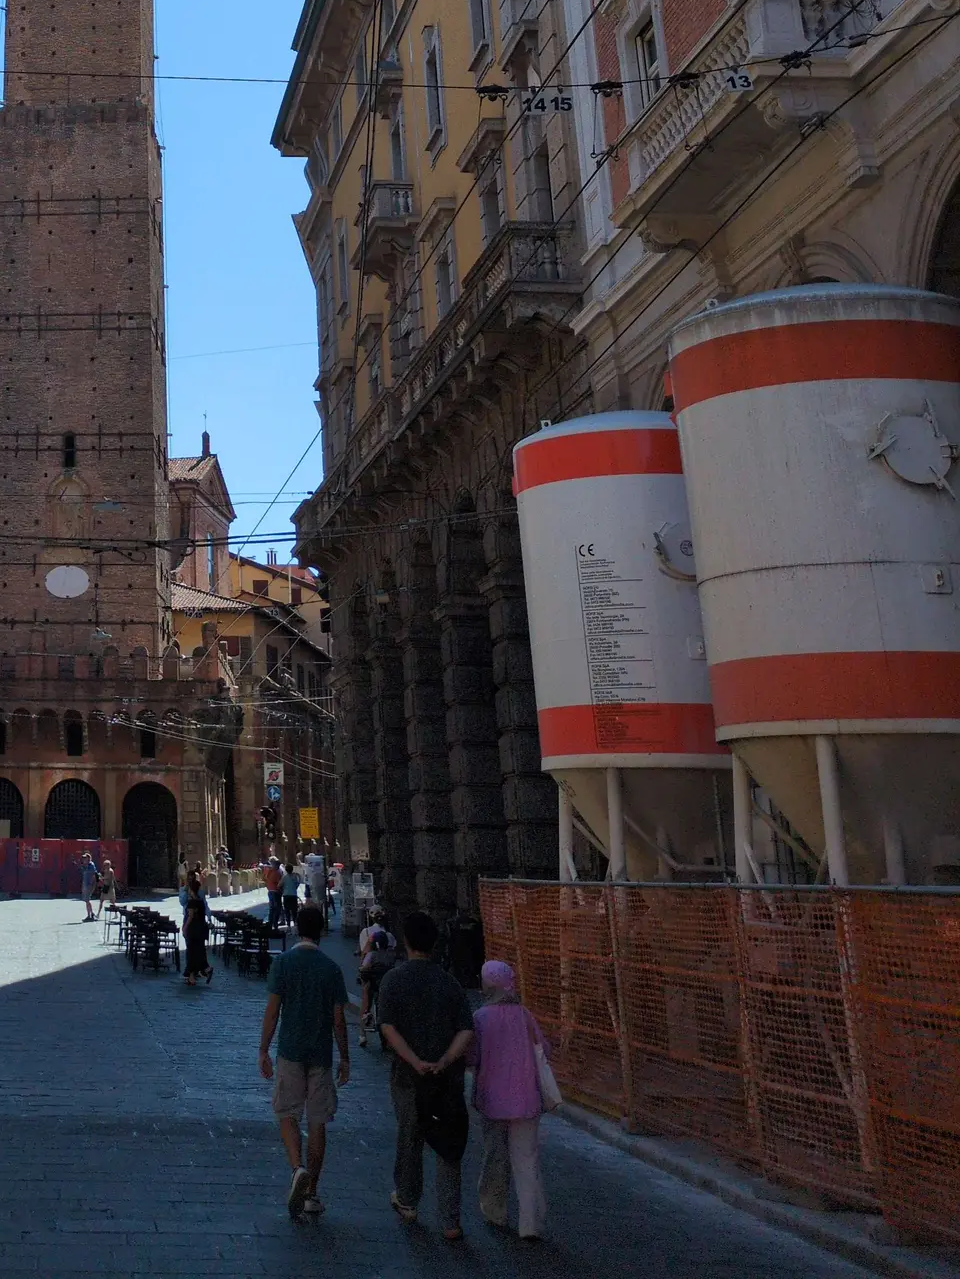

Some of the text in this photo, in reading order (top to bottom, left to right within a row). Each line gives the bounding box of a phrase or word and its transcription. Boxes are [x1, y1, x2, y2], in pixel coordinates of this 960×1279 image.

[727, 75, 752, 89] 13
[523, 96, 573, 112] 14 15
[578, 543, 595, 557] CE
